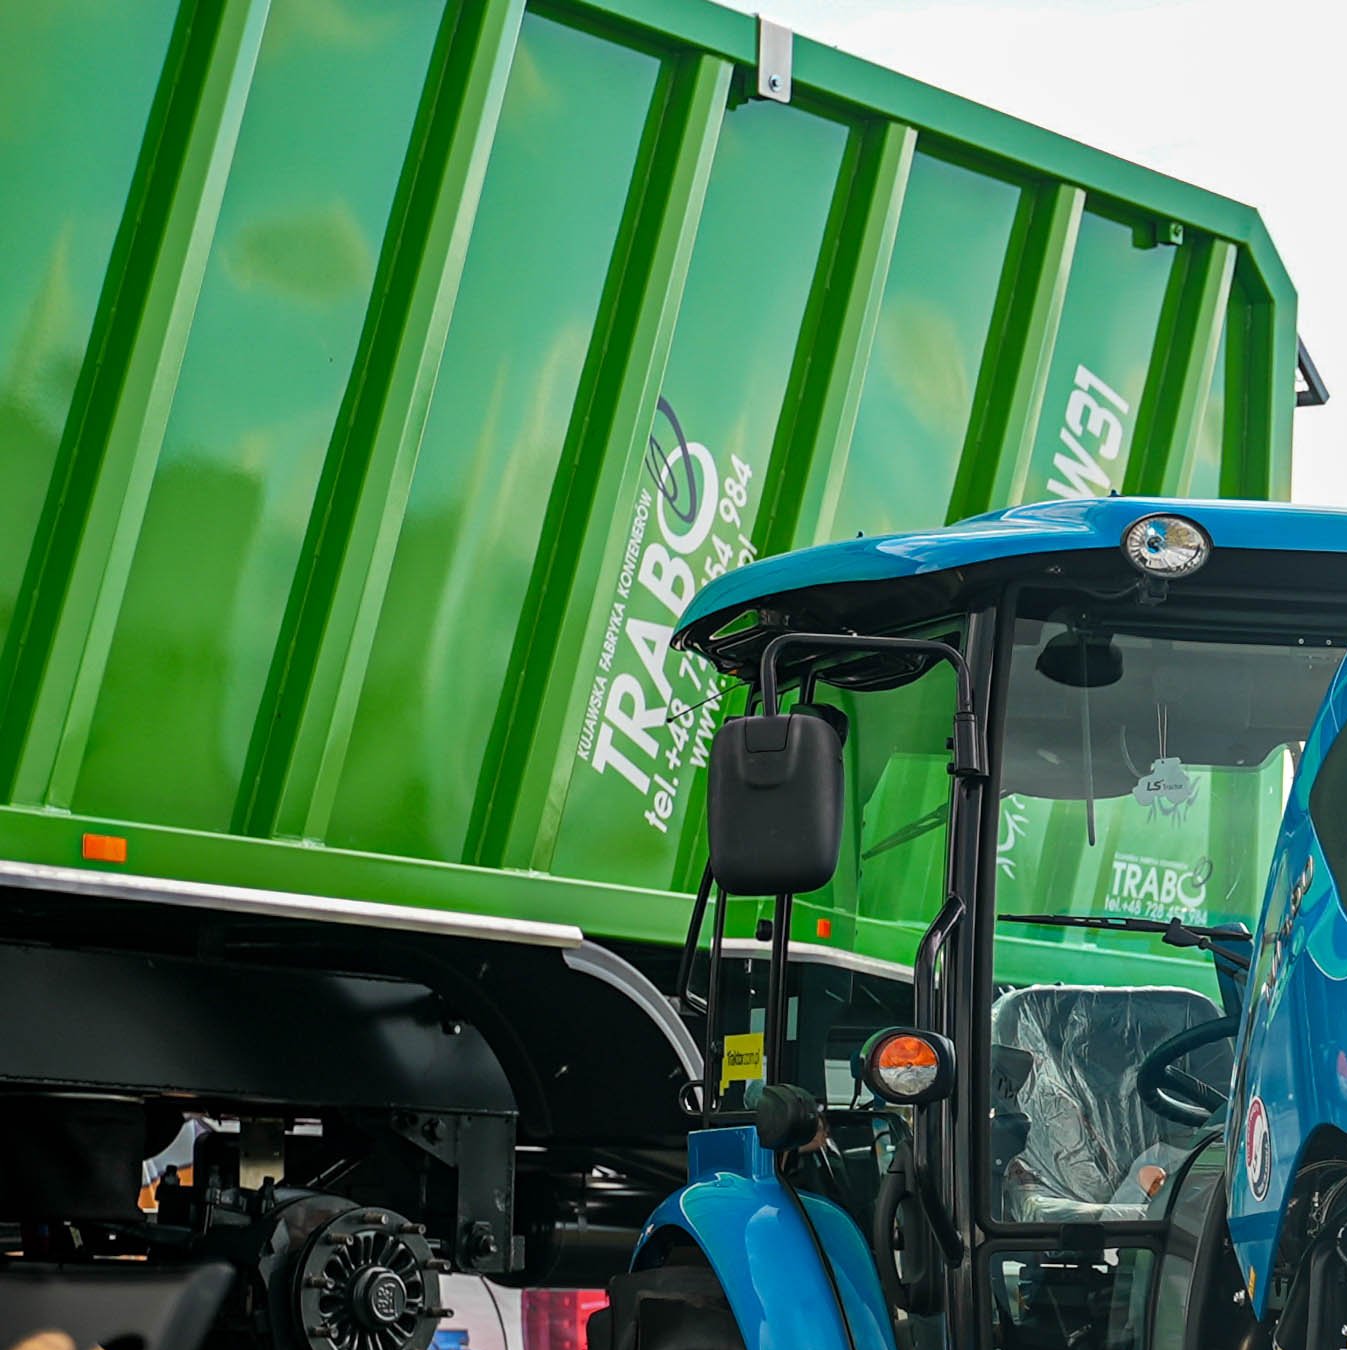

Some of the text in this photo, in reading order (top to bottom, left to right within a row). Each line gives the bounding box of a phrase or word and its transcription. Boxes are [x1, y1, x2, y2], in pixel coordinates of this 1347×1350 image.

[720, 453, 753, 530] 984
[577, 487, 653, 761] KUJAWSKA FABRYKA KONTENERÓW
[591, 441, 719, 795] TRABO
[1147, 779, 1164, 791] LS
[1112, 860, 1207, 909] TRABO
